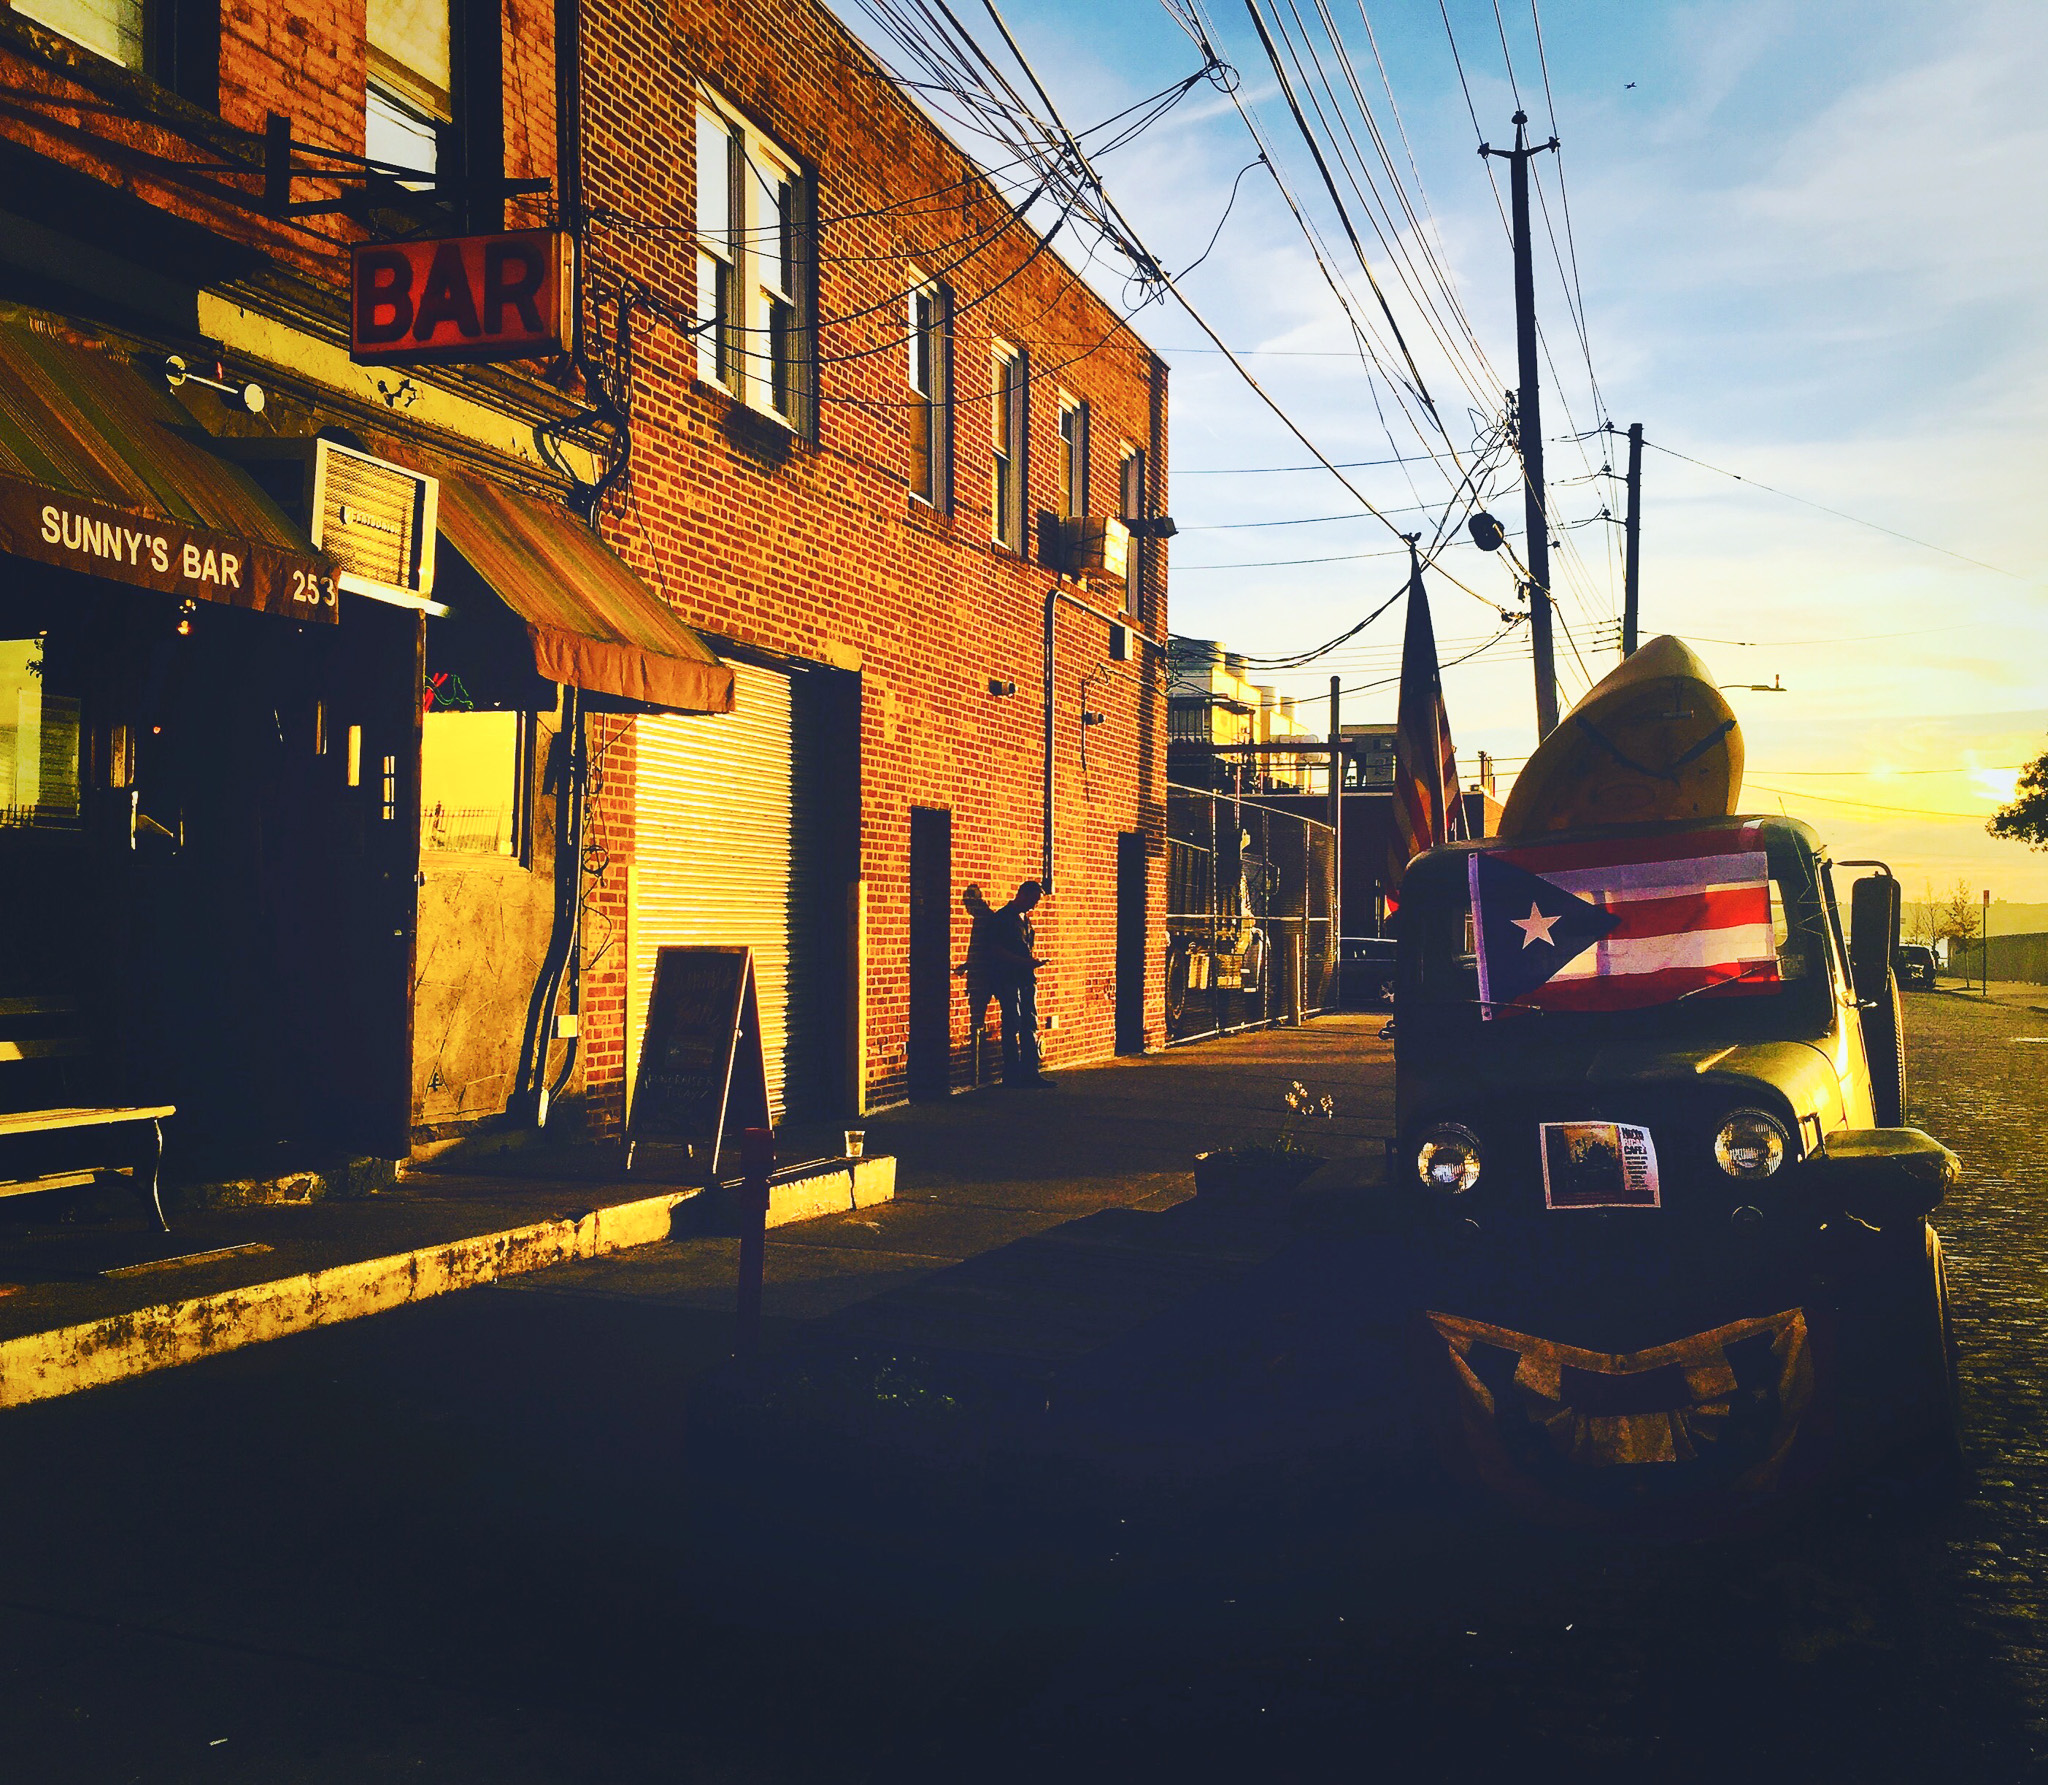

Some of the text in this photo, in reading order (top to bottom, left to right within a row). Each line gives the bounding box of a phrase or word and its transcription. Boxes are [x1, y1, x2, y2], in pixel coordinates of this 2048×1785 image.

[357, 240, 545, 344] BAR
[41, 505, 240, 589] SUNNY'S BAR
[292, 570, 336, 606] 253
